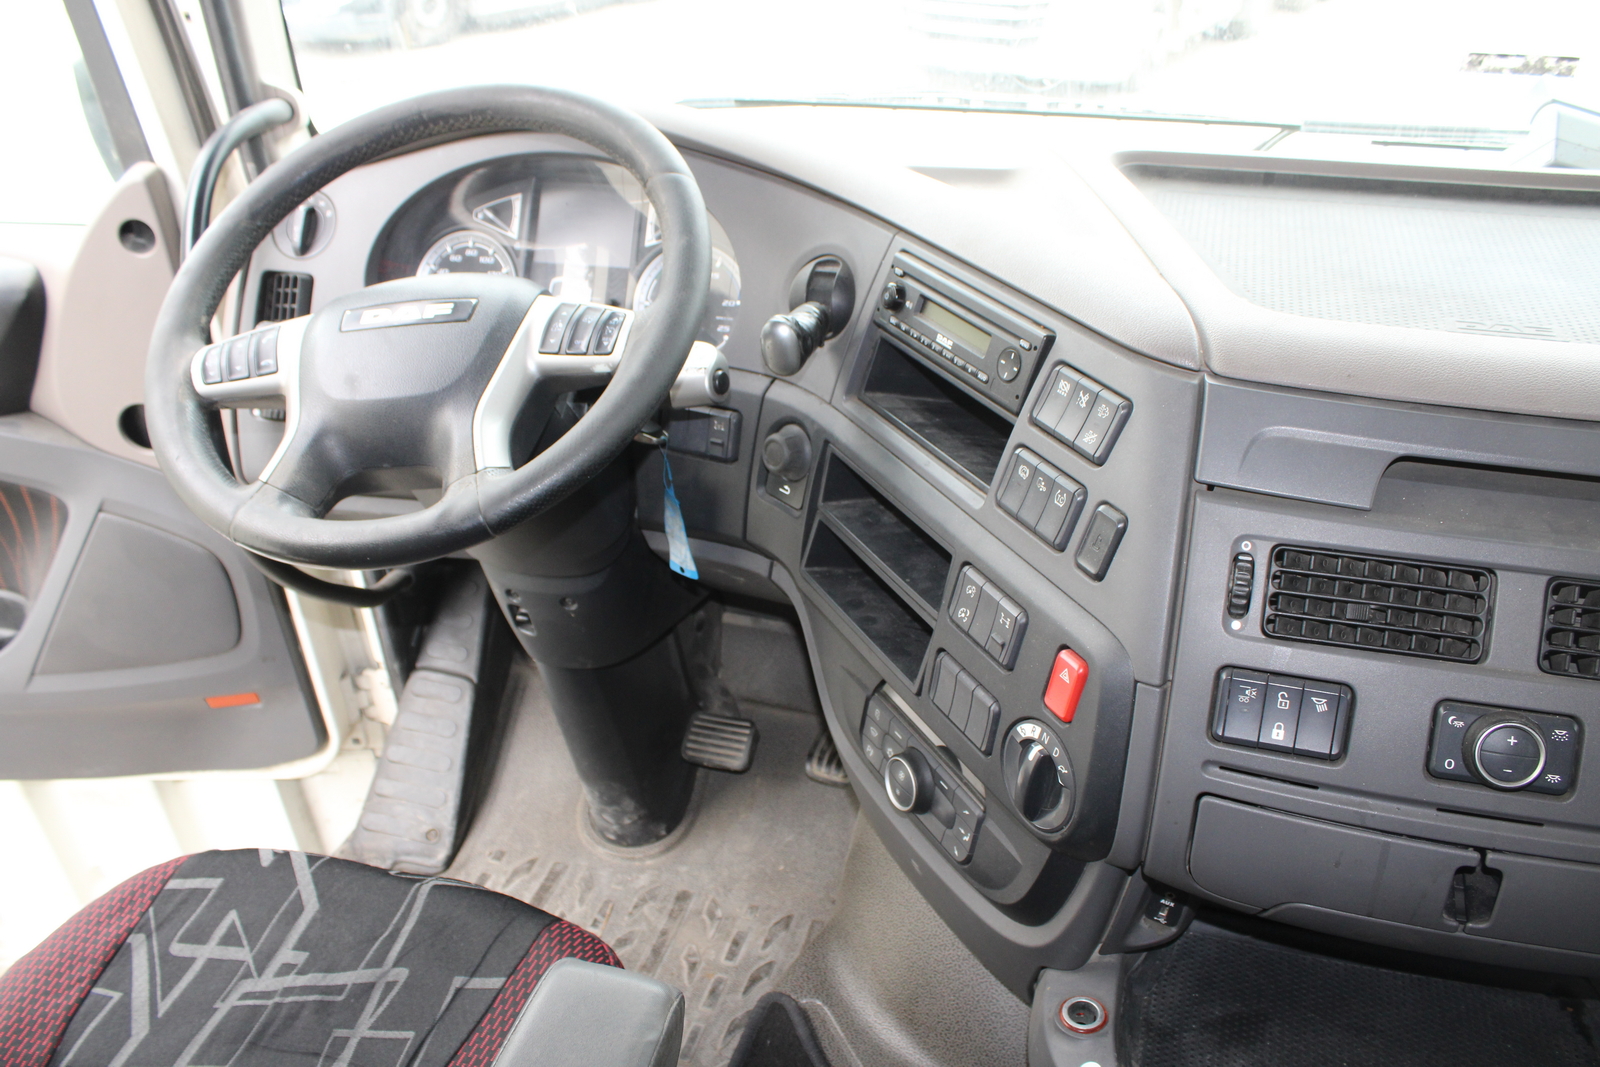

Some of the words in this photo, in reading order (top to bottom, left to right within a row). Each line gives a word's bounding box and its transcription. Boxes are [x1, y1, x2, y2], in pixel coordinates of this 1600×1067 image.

[360, 302, 455, 325] DAF
[936, 333, 953, 347] DAF
[1041, 732, 1050, 745] N
[1052, 746, 1060, 757] D
